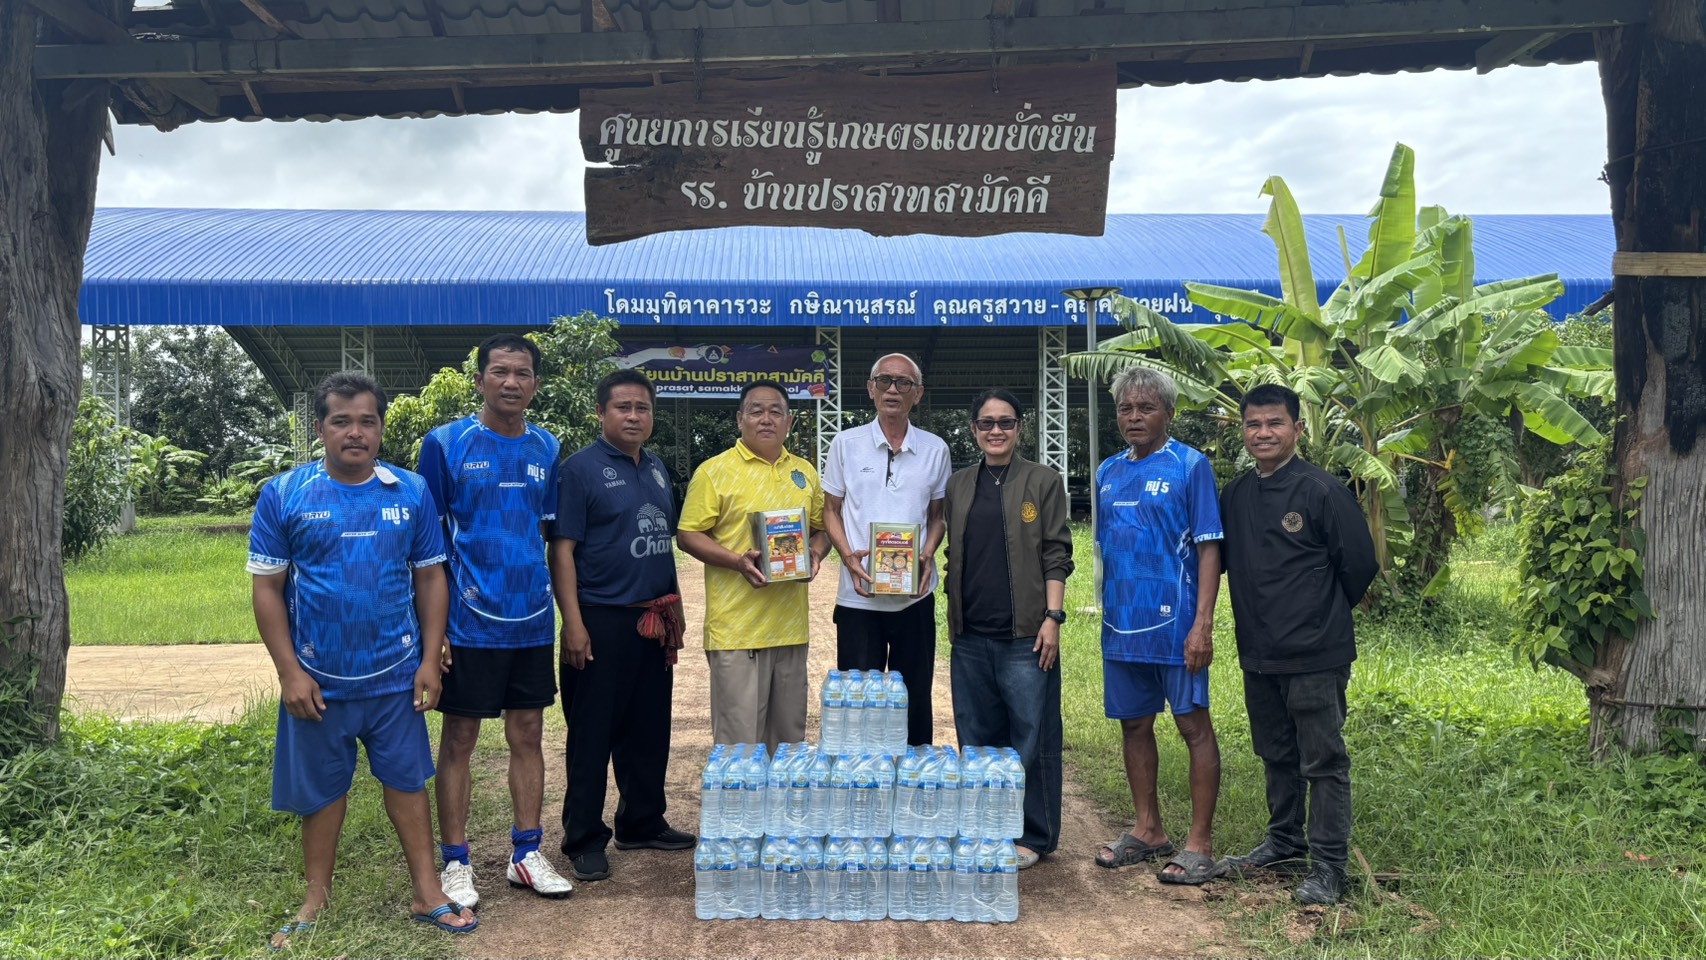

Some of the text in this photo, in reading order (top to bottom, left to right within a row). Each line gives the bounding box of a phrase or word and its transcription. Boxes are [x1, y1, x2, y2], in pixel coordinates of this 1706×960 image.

[743, 168, 1051, 214] บ้านปราสาทสามัคคี
[604, 288, 772, 323] โดมมุทิตาคารวะ
[789, 289, 918, 324] กษิณานุสรณ์
[933, 297, 1047, 323] คุณครูสวาย
[656, 383, 694, 393] prasat
[698, 384, 744, 393] samakk
[604, 479, 626, 489] YAMAHA
